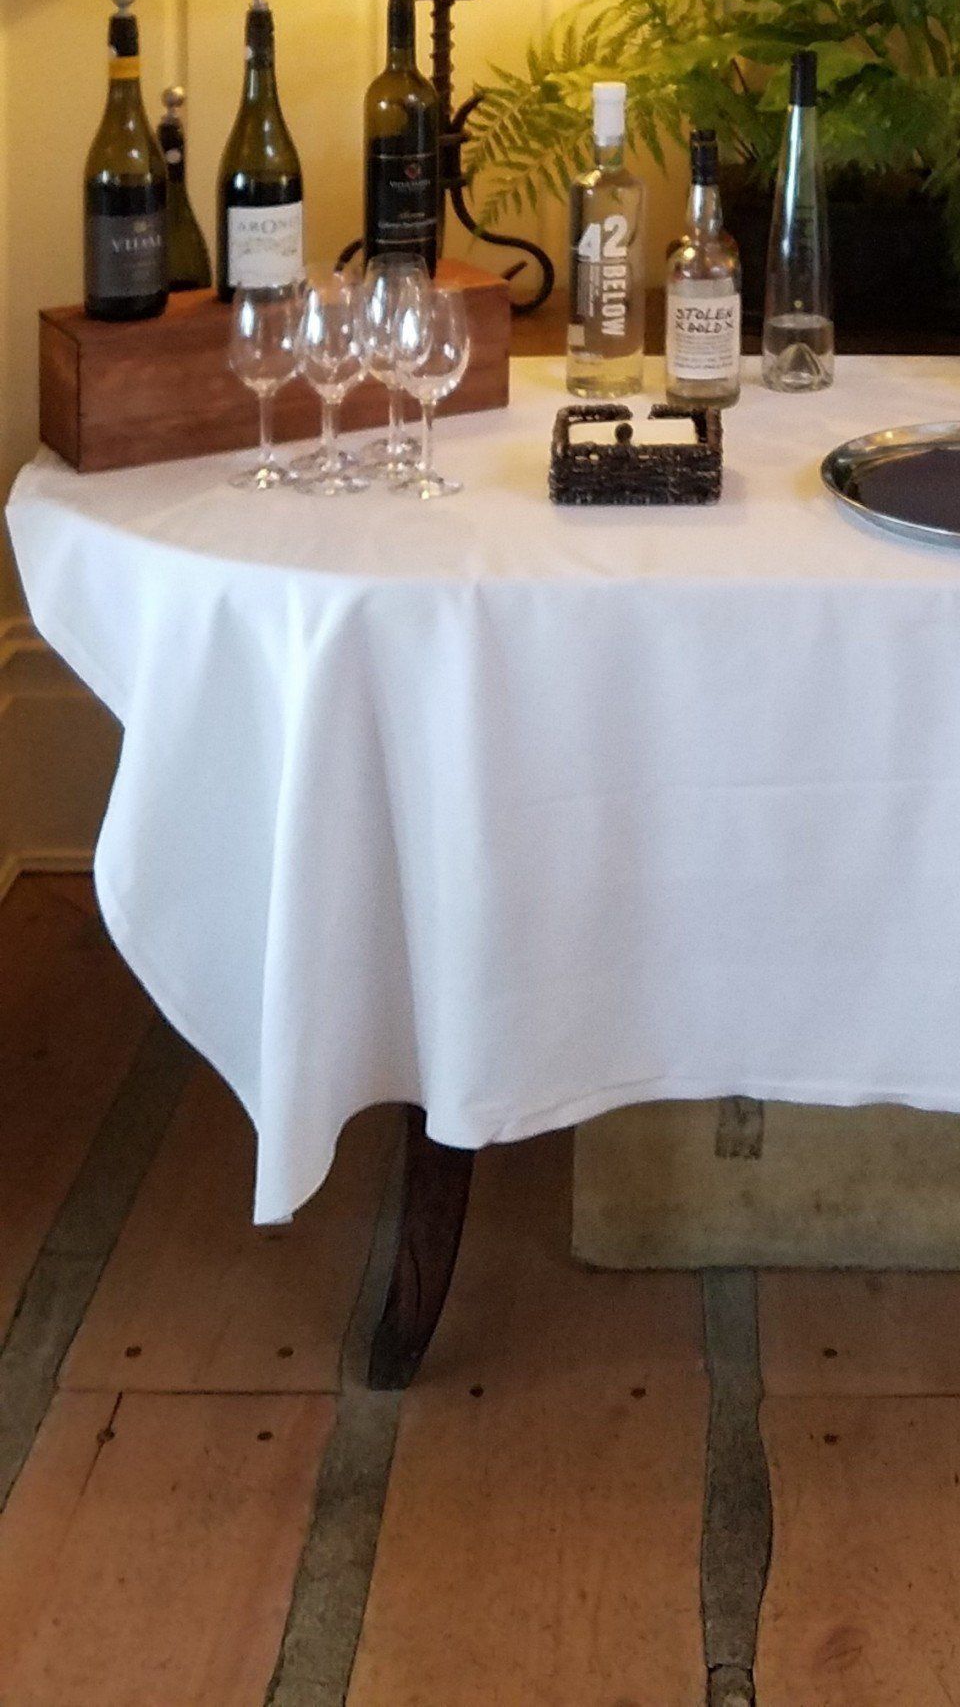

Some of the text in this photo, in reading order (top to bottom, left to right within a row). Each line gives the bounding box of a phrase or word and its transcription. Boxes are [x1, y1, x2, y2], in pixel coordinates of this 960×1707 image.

[578, 215, 627, 263] 42
[601, 265, 626, 336] BELOW
[675, 307, 734, 320] STOLEN
